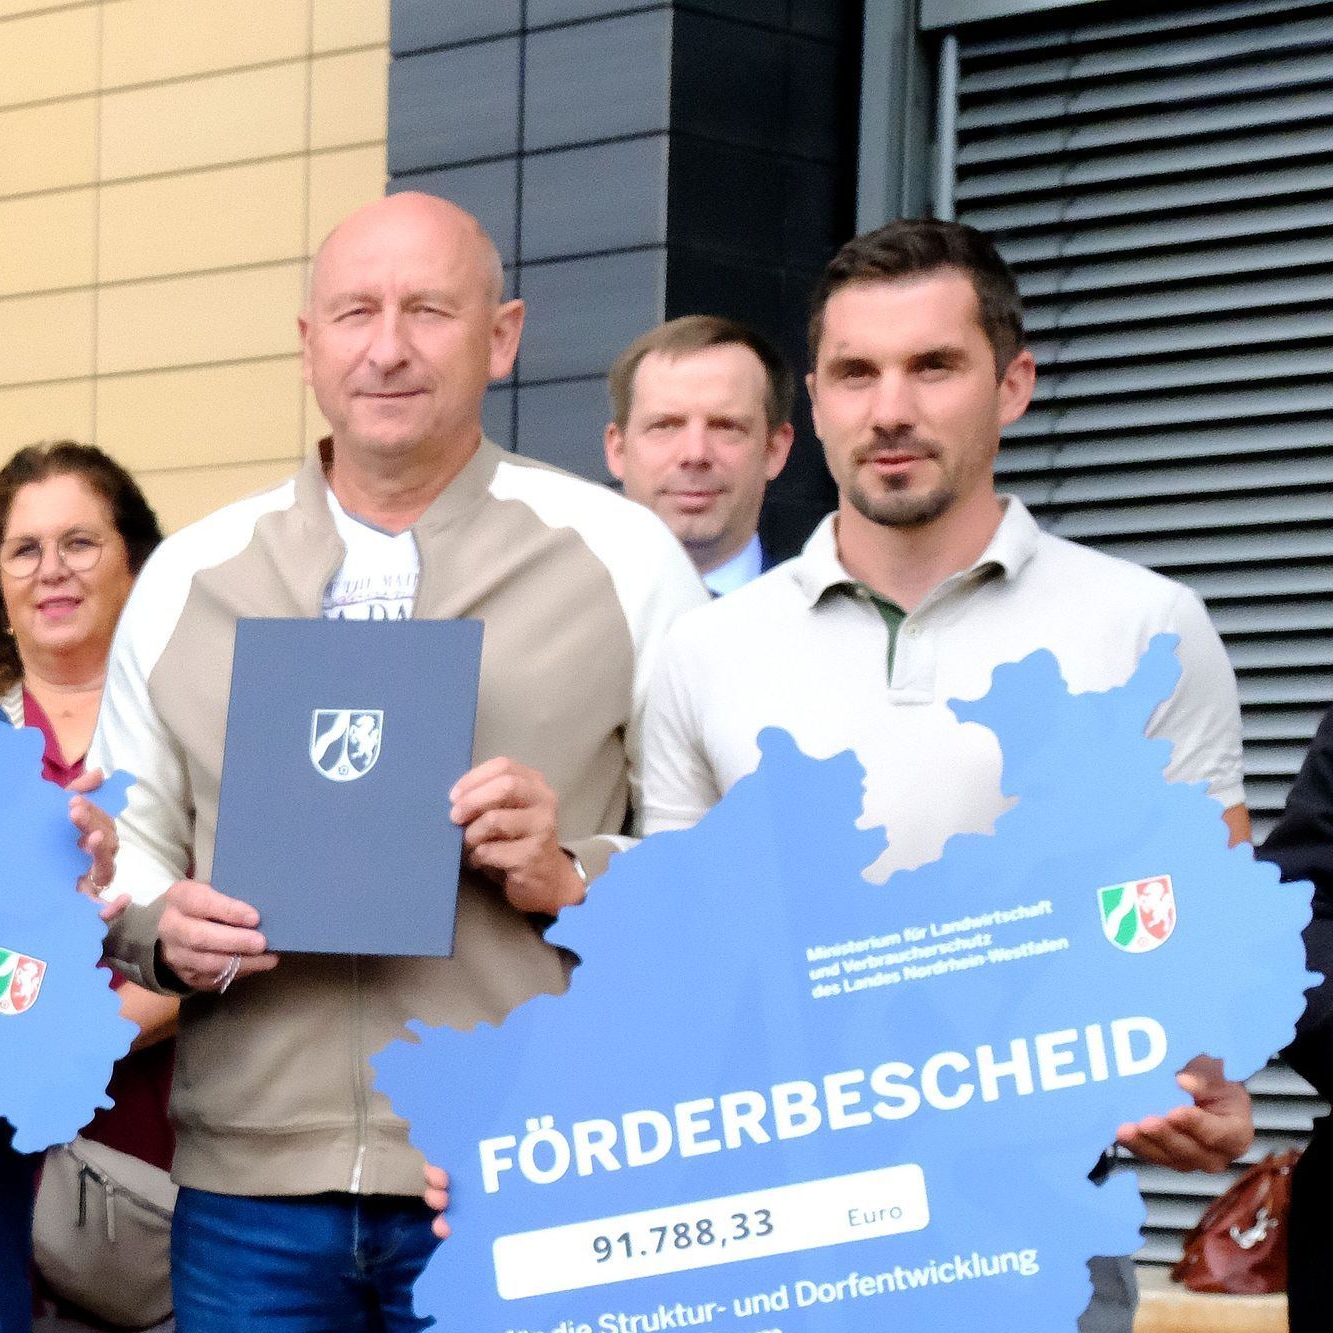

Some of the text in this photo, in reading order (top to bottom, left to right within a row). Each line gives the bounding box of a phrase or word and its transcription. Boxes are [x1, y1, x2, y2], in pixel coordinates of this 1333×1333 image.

[479, 1017, 1167, 1193] FÖRDERBESCHEID
[593, 1207, 903, 1263] 91.788,33 Euro
[734, 1285, 789, 1317] und
[795, 1249, 1039, 1307] Dorfentwicklung
